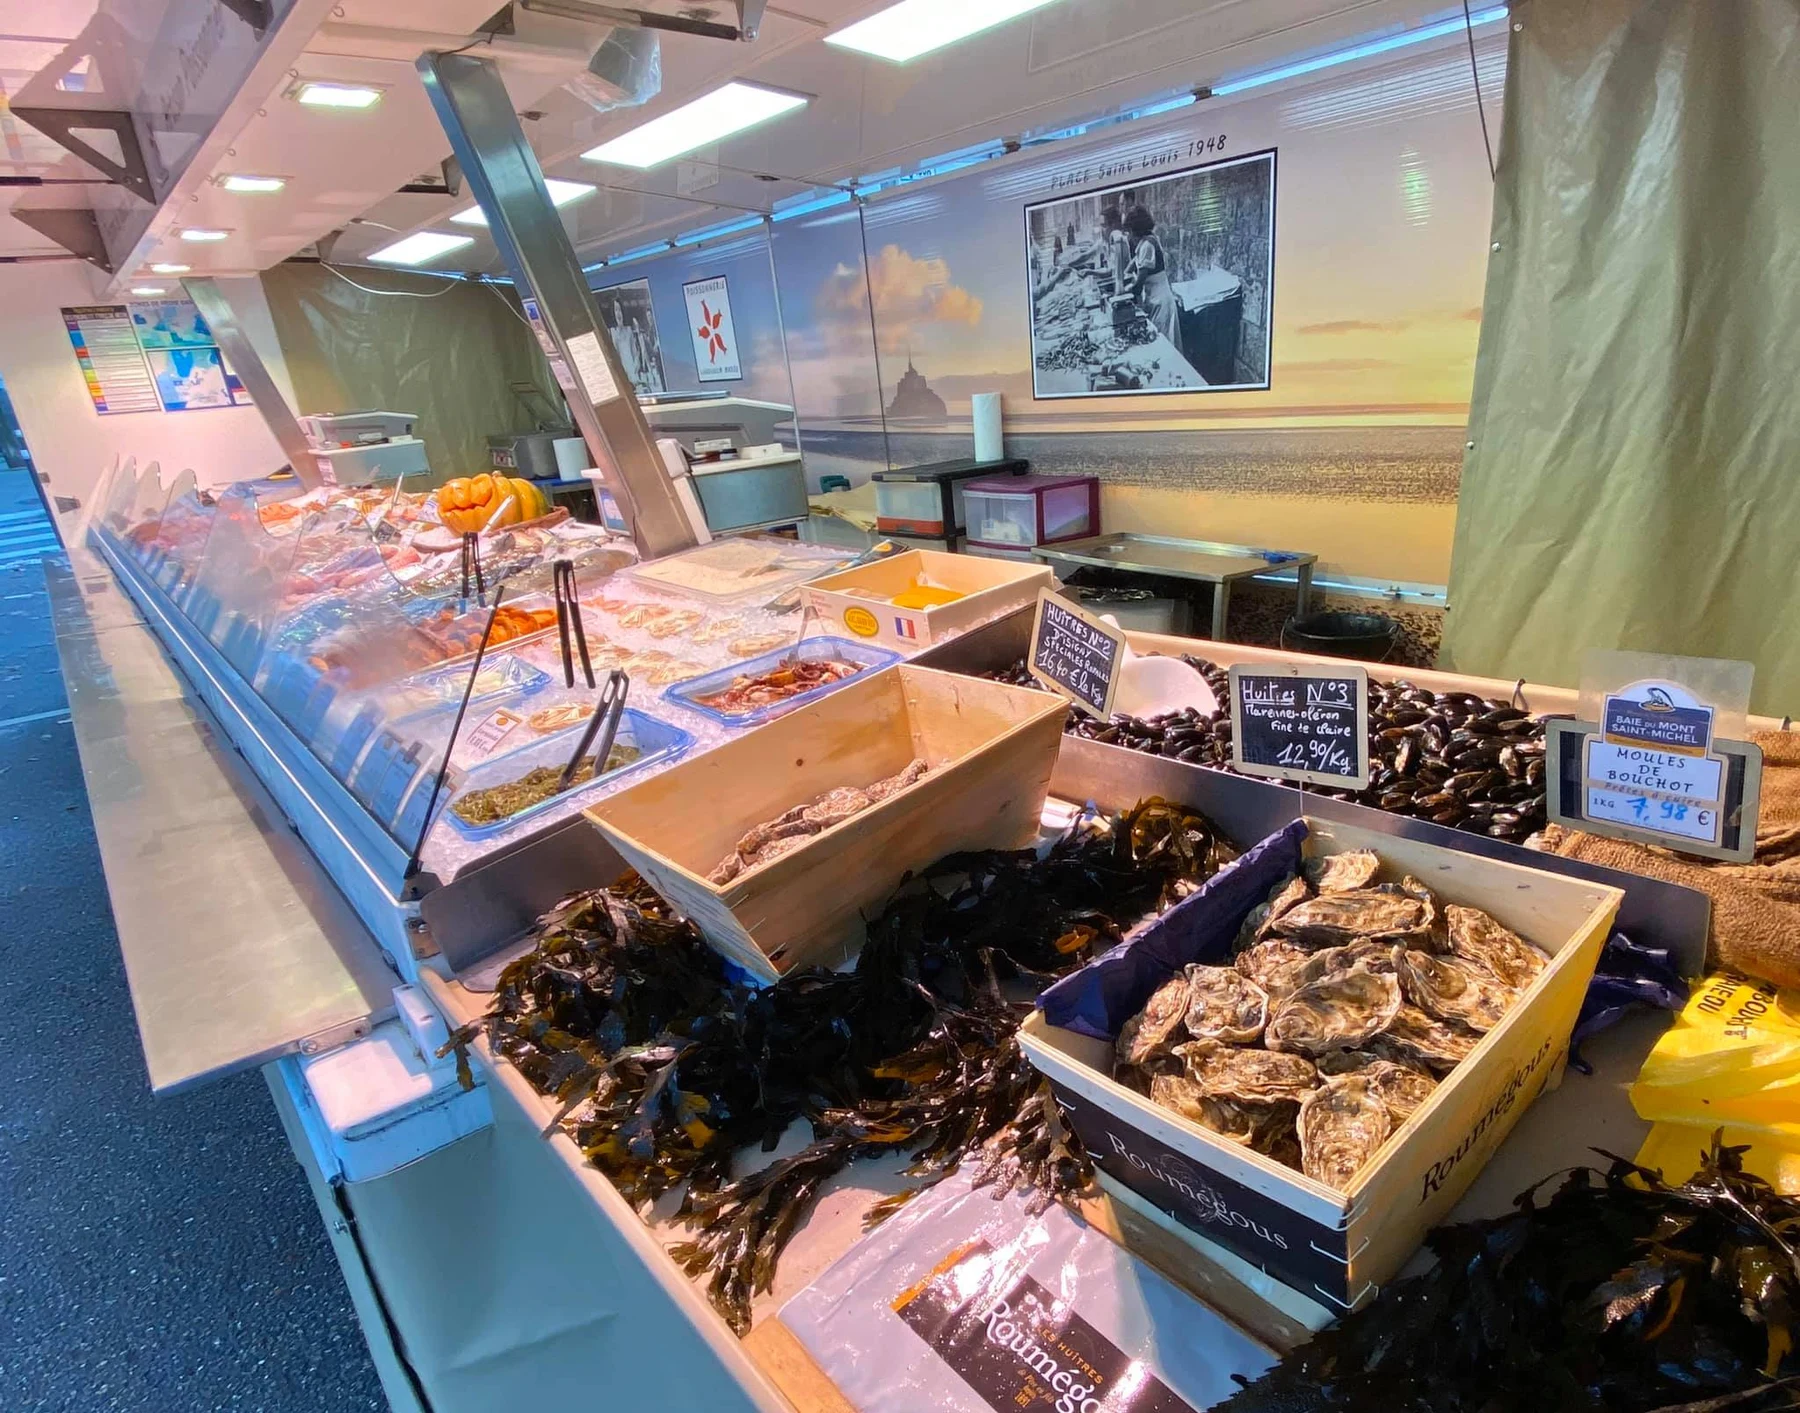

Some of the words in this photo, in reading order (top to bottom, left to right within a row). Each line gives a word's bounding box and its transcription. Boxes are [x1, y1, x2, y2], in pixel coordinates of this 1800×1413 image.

[1051, 168, 1090, 190] PLACE
[1099, 160, 1133, 178] Saint
[1142, 149, 1179, 168] Louis
[1187, 134, 1228, 157] 1948
[1047, 603, 1088, 638] HUÎTRES
[1038, 649, 1069, 677] 16,40
[1306, 681, 1348, 703] N°3
[1271, 720, 1293, 733] Fine
[1612, 724, 1699, 744] SAINT-MICHEL
[1616, 715, 1642, 727] BAIE
[1658, 721, 1696, 734] MONT
[1616, 747, 1687, 769] MOULES
[1607, 769, 1695, 793] BOUCHOT
[1639, 764, 1662, 777] DE
[1697, 810, 1711, 826] €
[1105, 1130, 1288, 1250] Roumégous
[1057, 1342, 1104, 1385] HUÎTRES
